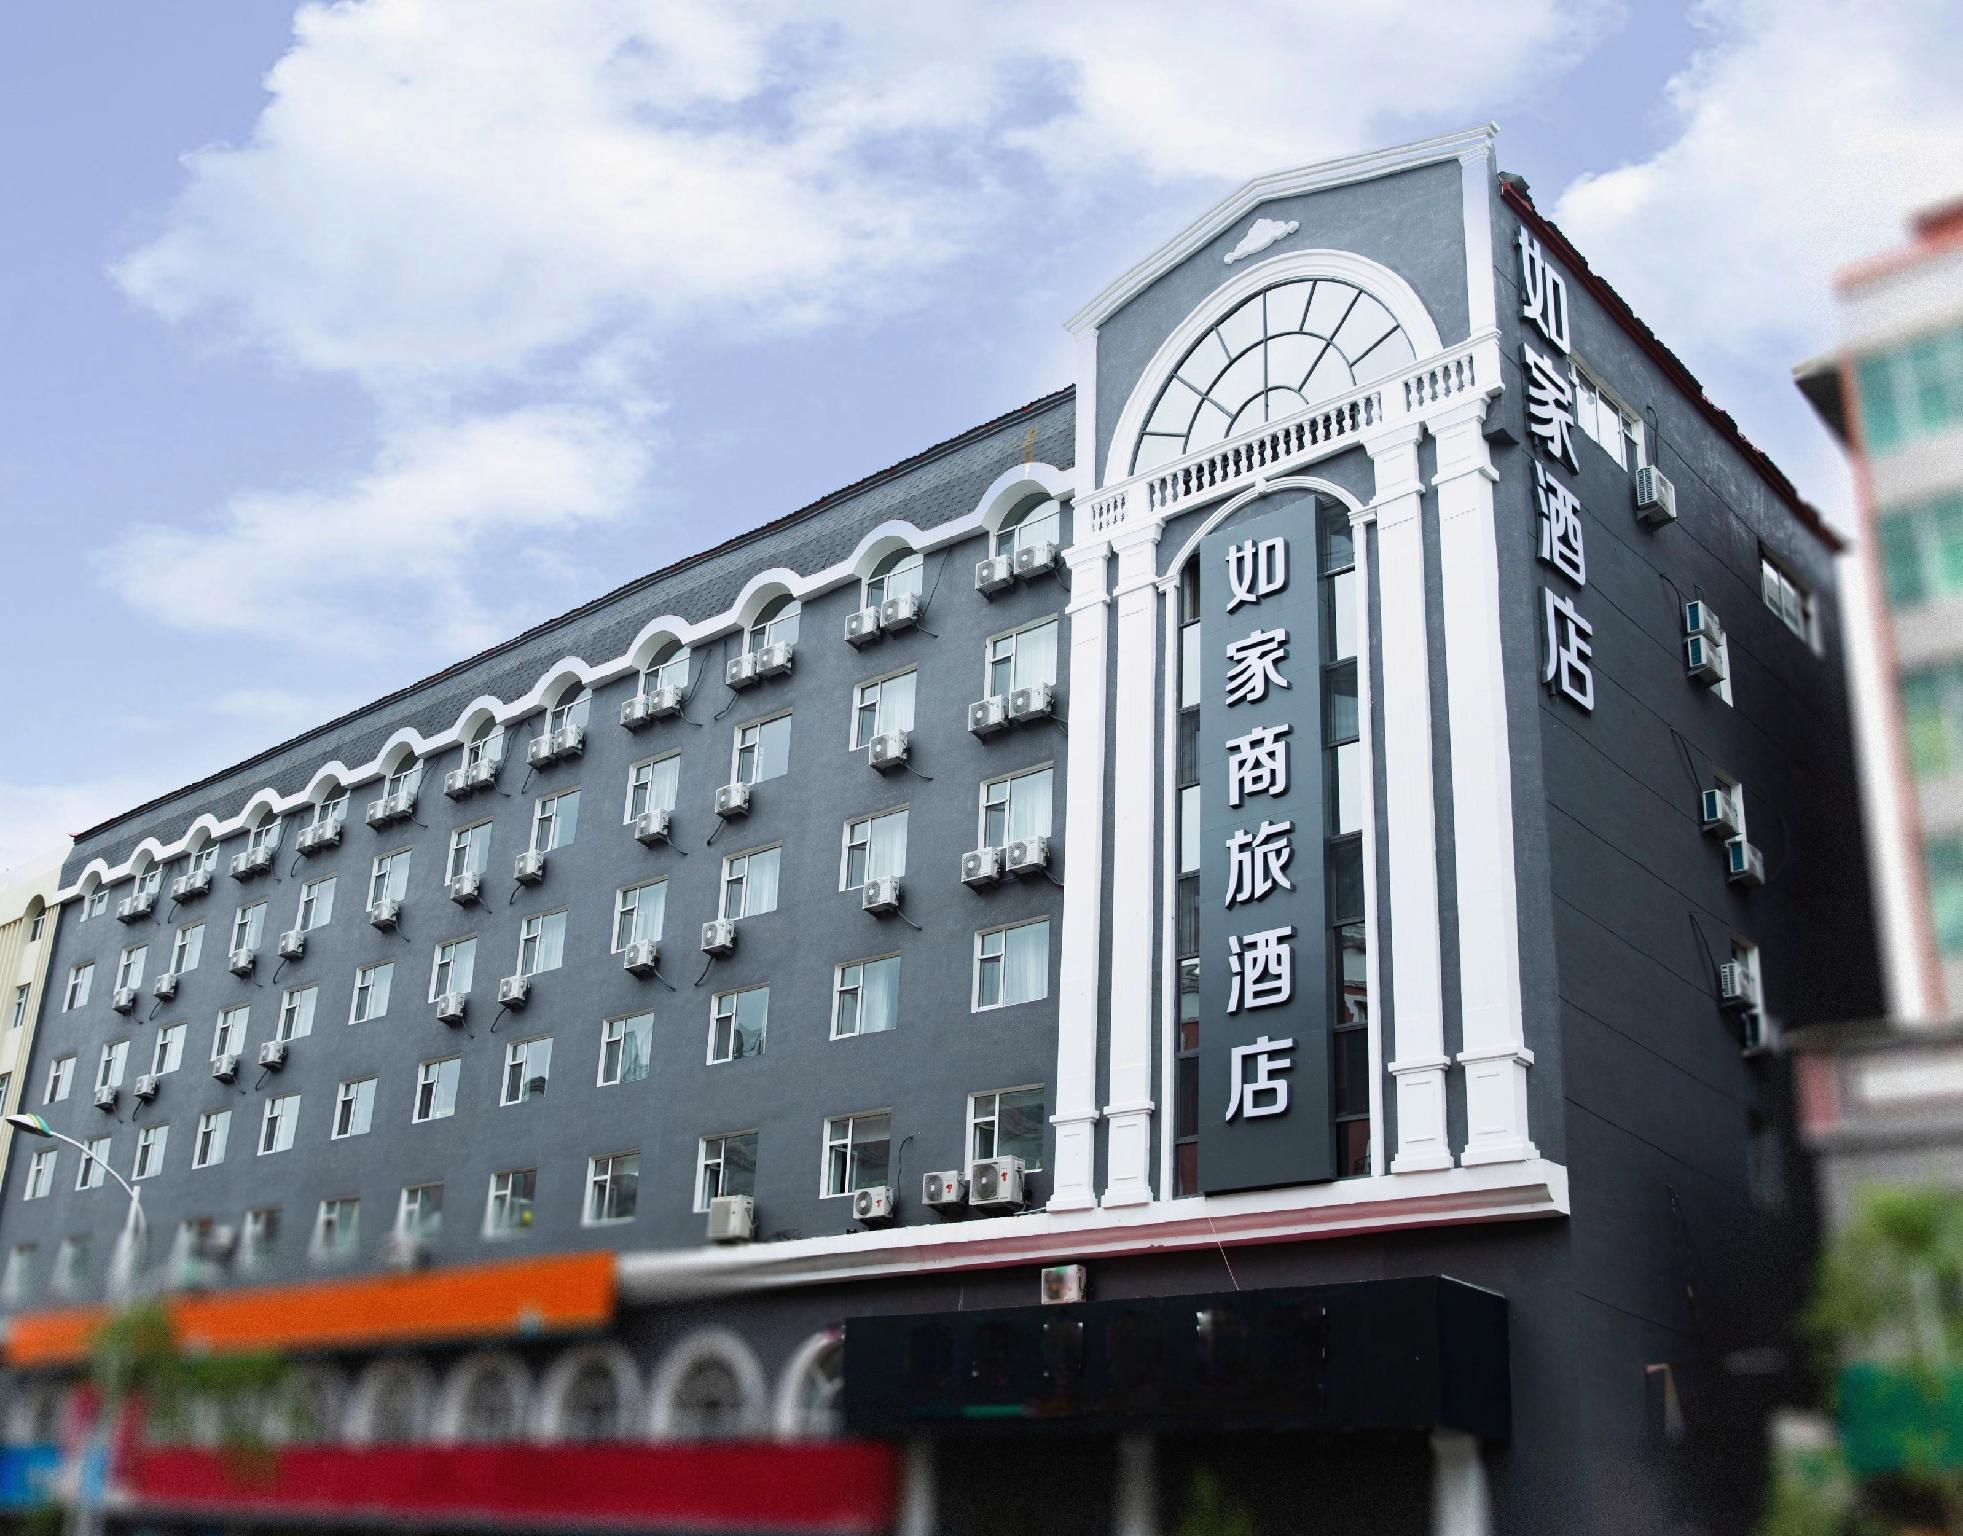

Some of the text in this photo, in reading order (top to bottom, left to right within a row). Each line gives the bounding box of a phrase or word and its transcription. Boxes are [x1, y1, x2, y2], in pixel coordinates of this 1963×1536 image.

[1518, 225, 1594, 710] 如家酒店
[1225, 537, 1295, 1121] 如家商旅酒店
